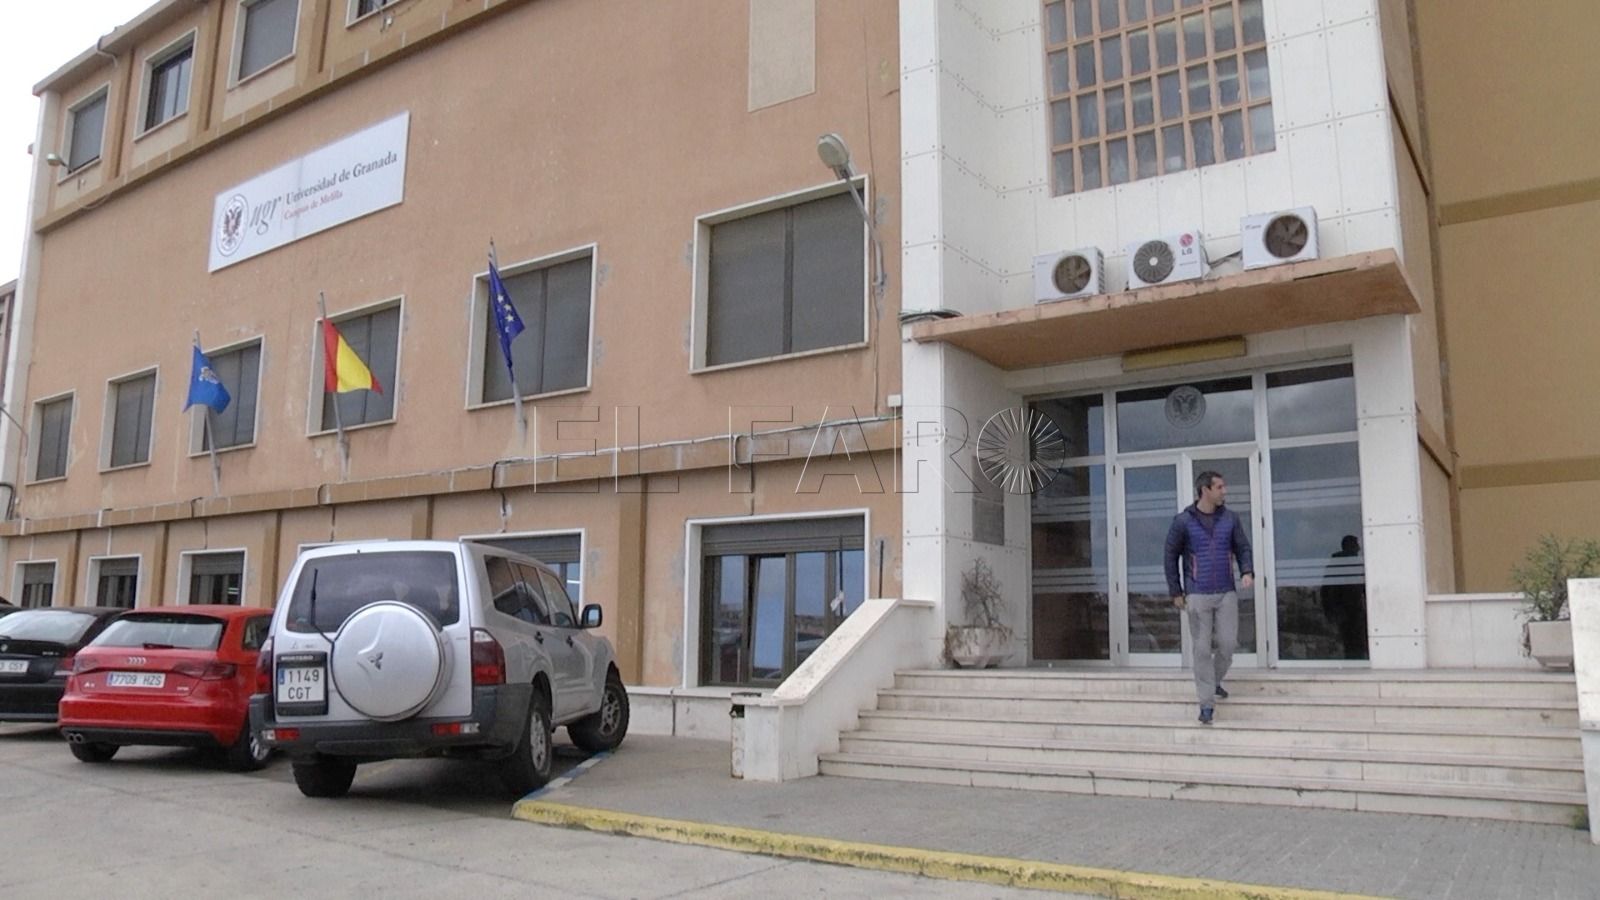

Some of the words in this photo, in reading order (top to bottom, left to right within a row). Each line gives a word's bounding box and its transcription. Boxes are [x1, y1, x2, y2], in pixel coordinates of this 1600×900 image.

[286, 172, 337, 205] Universidad
[338, 167, 351, 183] de
[352, 151, 398, 178] Granada
[114, 673, 138, 685] 7709
[143, 674, 162, 686] HZS
[288, 668, 320, 683] 1149
[288, 686, 312, 700] CGT
